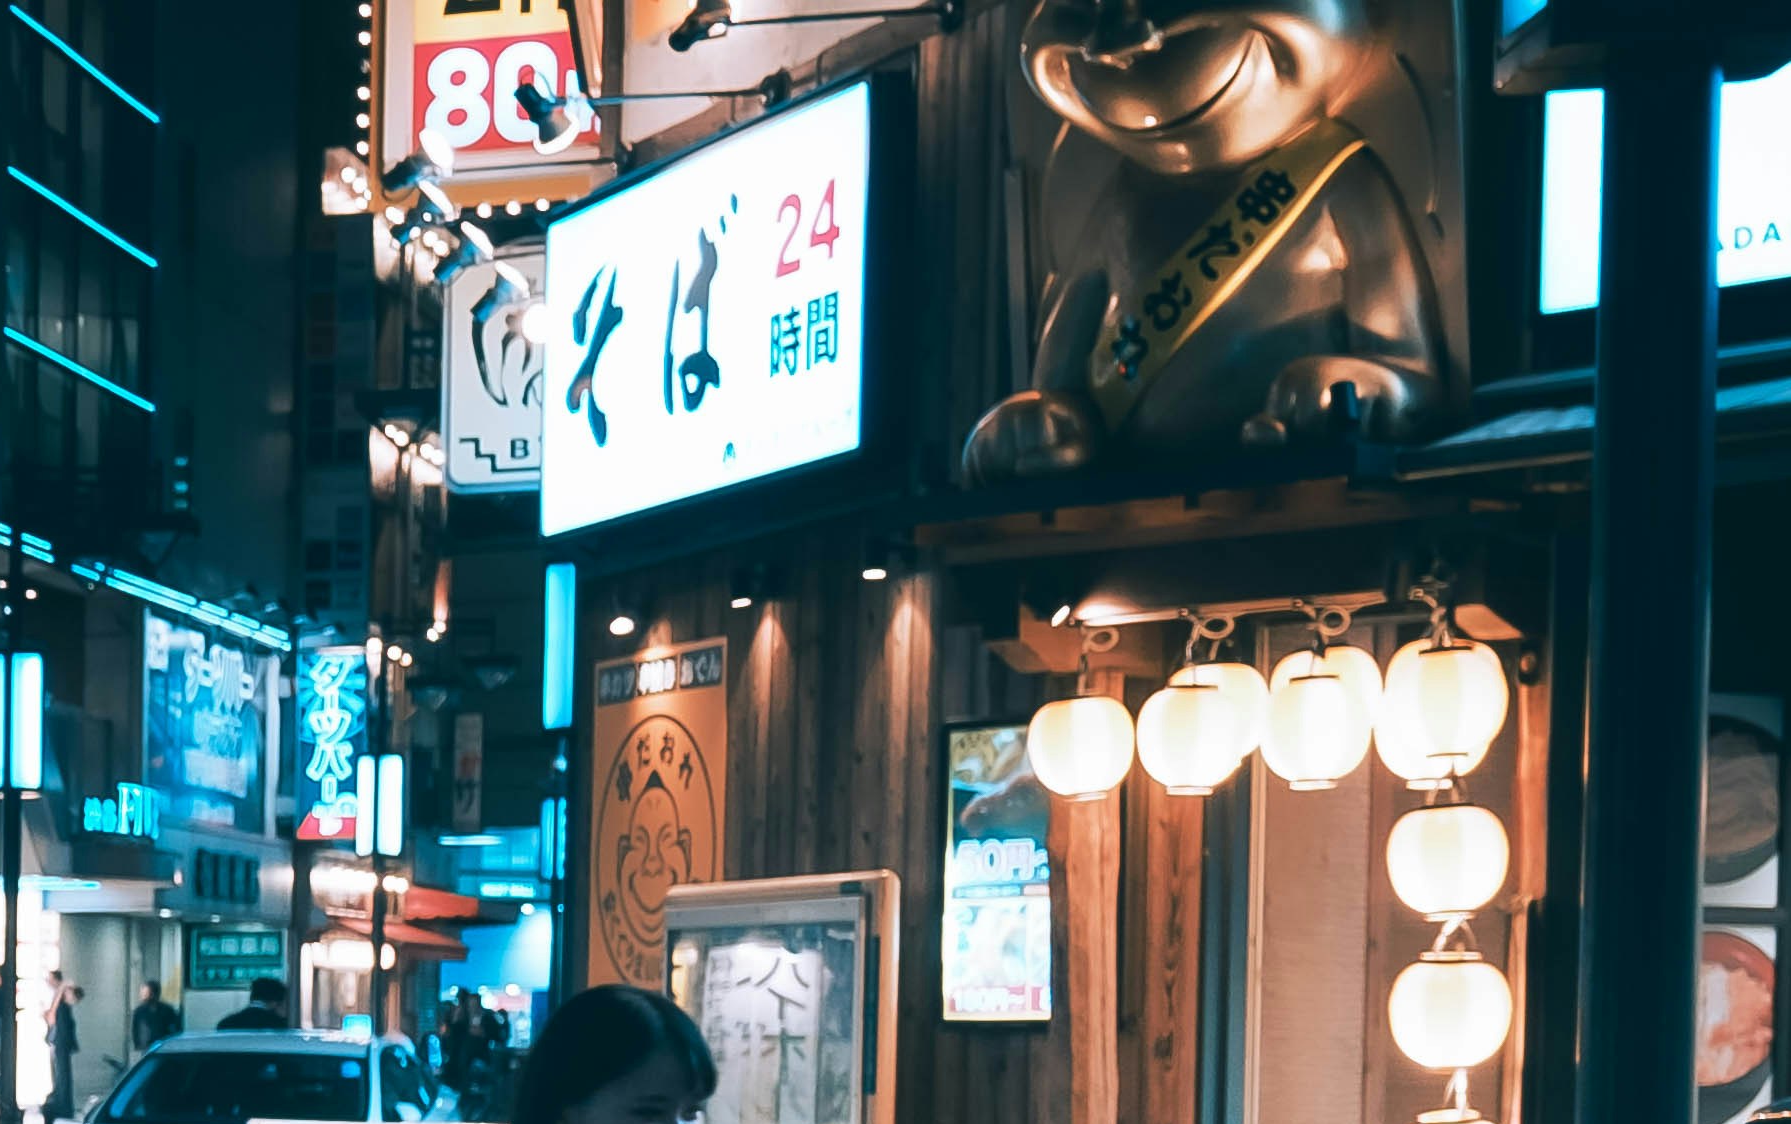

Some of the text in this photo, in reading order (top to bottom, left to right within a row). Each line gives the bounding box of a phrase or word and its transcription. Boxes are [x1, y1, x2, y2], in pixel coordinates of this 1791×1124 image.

[775, 178, 840, 279] 24
[567, 192, 739, 448] そば
[770, 291, 839, 378] 時間
